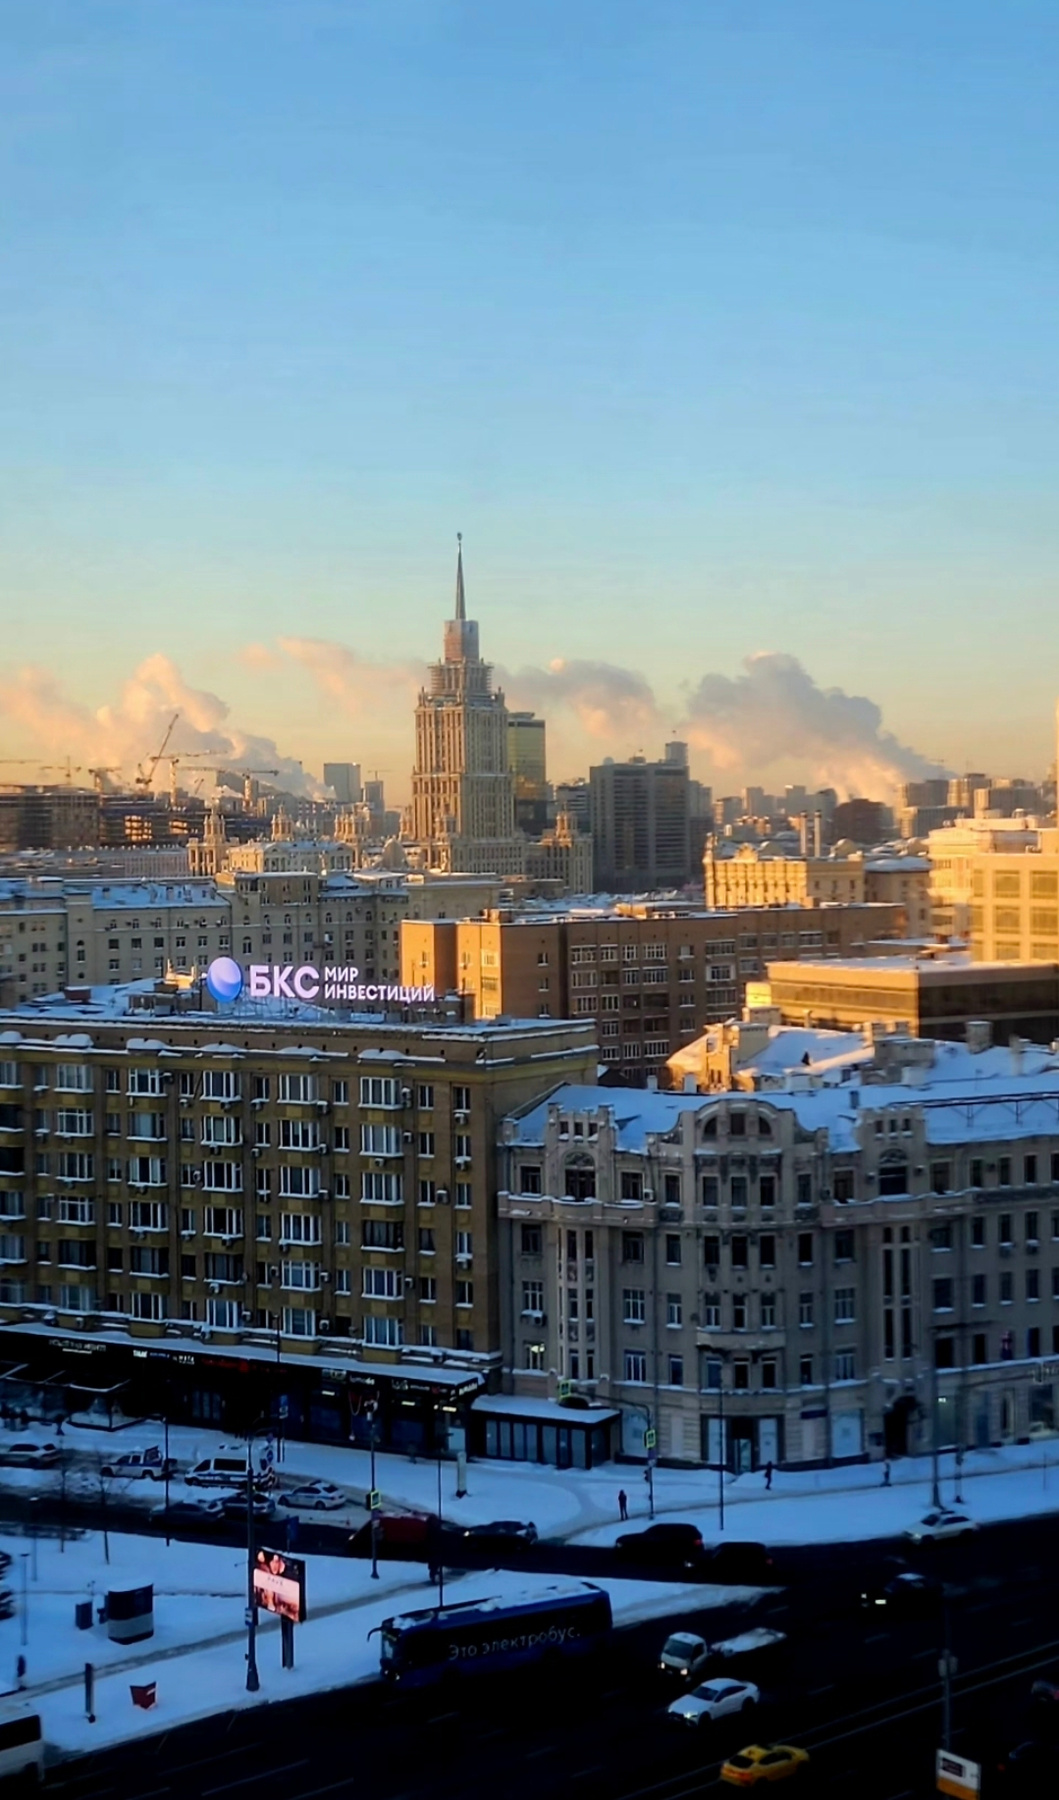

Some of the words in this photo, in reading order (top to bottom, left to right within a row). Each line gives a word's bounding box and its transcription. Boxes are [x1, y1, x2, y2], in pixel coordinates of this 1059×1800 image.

[250, 965, 320, 998] БКС
[324, 966, 359, 982] МИР
[324, 983, 435, 1004] ИНВЕСТИЦИЙ
[449, 1643, 478, 1661] Это
[482, 1625, 581, 1654] электробус.
